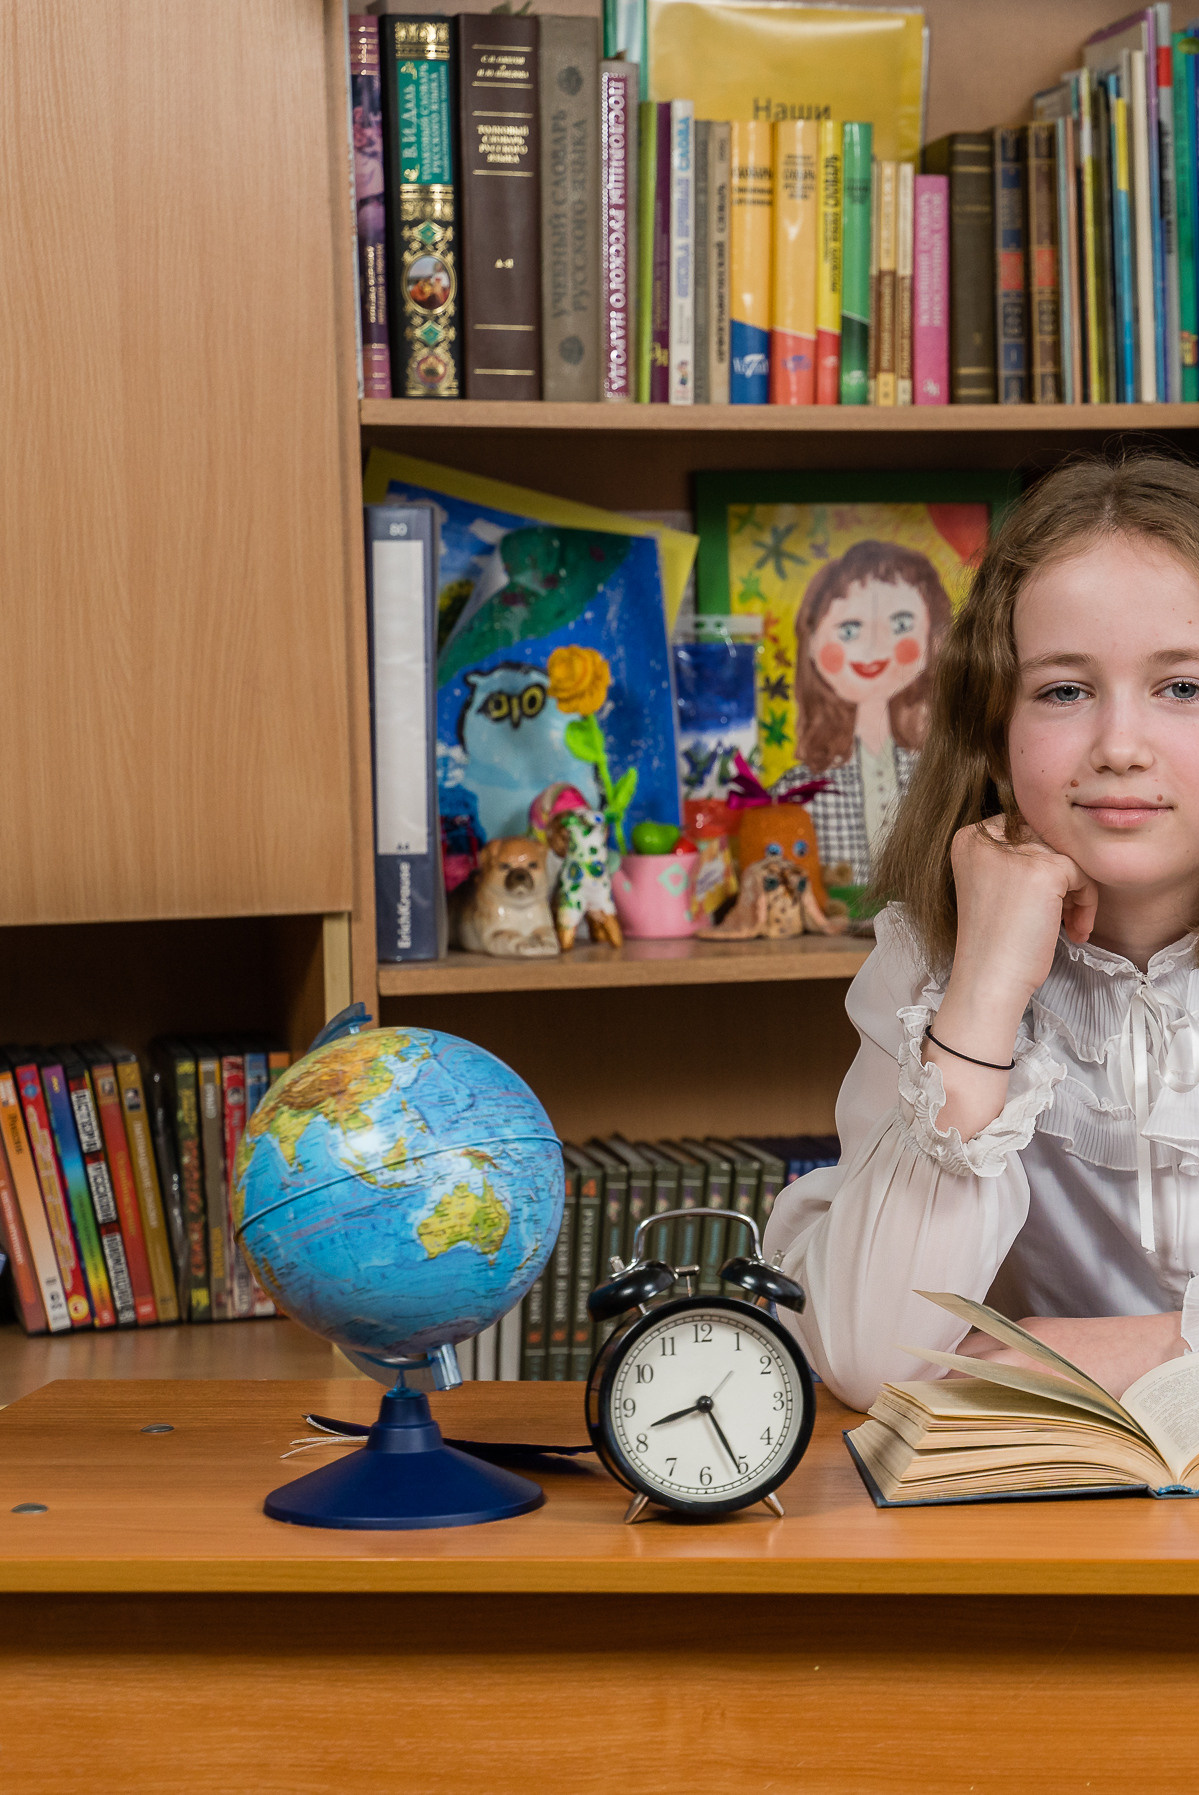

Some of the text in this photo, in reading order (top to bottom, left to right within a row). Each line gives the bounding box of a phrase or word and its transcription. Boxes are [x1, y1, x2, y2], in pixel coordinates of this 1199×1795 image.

[753, 97, 832, 121] Наши
[550, 110, 567, 206] СЛОВАРЬ
[608, 80, 627, 391] ПОСЛОВИЦЫ РУССКОГО НАРОДА
[571, 199, 590, 313] РУССКОГО
[692, 1322, 713, 1343] 12
[733, 1331, 742, 1352] 1
[660, 1336, 676, 1357] 11
[635, 1364, 655, 1385] 10
[759, 1355, 773, 1375] 2
[622, 1398, 637, 1418] 9
[772, 1391, 785, 1412] 3
[636, 1432, 649, 1454] 8
[759, 1426, 774, 1446] 4
[664, 1456, 678, 1478] 7
[736, 1455, 750, 1475] 5
[699, 1465, 713, 1487] 6
